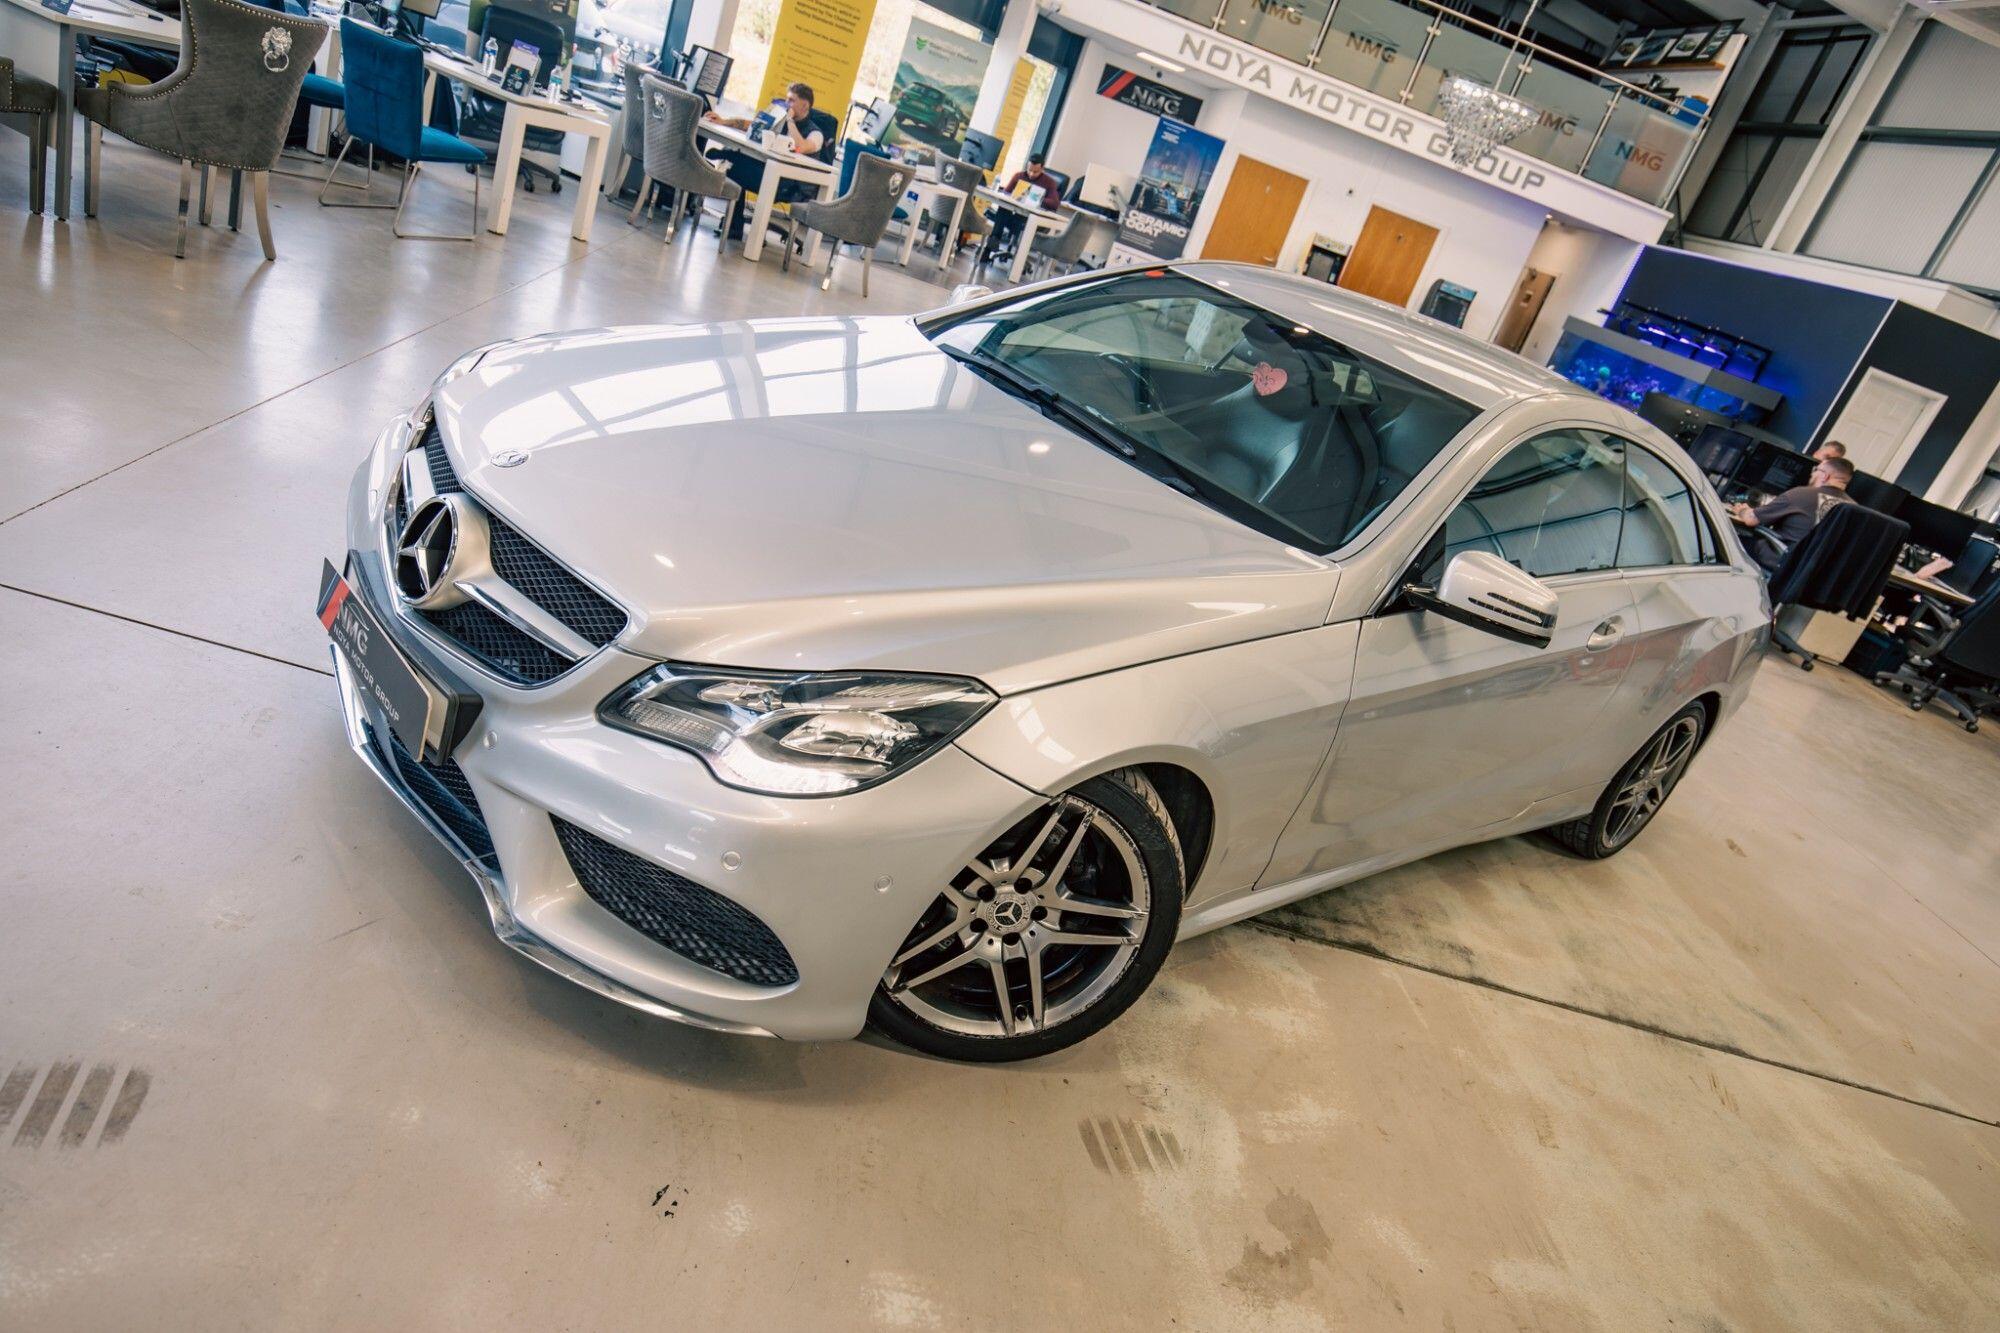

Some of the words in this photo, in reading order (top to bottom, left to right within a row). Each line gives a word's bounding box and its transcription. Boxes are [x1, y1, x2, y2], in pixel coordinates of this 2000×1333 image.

[1345, 31, 1398, 64] NMG
[1131, 84, 1181, 115] NMG
[1179, 33, 1272, 89] NOYA
[1289, 77, 1414, 143] MOTOR
[1426, 133, 1546, 191] GOUP
[1614, 141, 1668, 172] NMG
[1125, 218, 1162, 238] COAT
[1128, 209, 1188, 239] CERAMIC
[336, 597, 370, 657] NMG
[350, 650, 375, 688] MOTOR
[374, 684, 401, 721] GROUP
